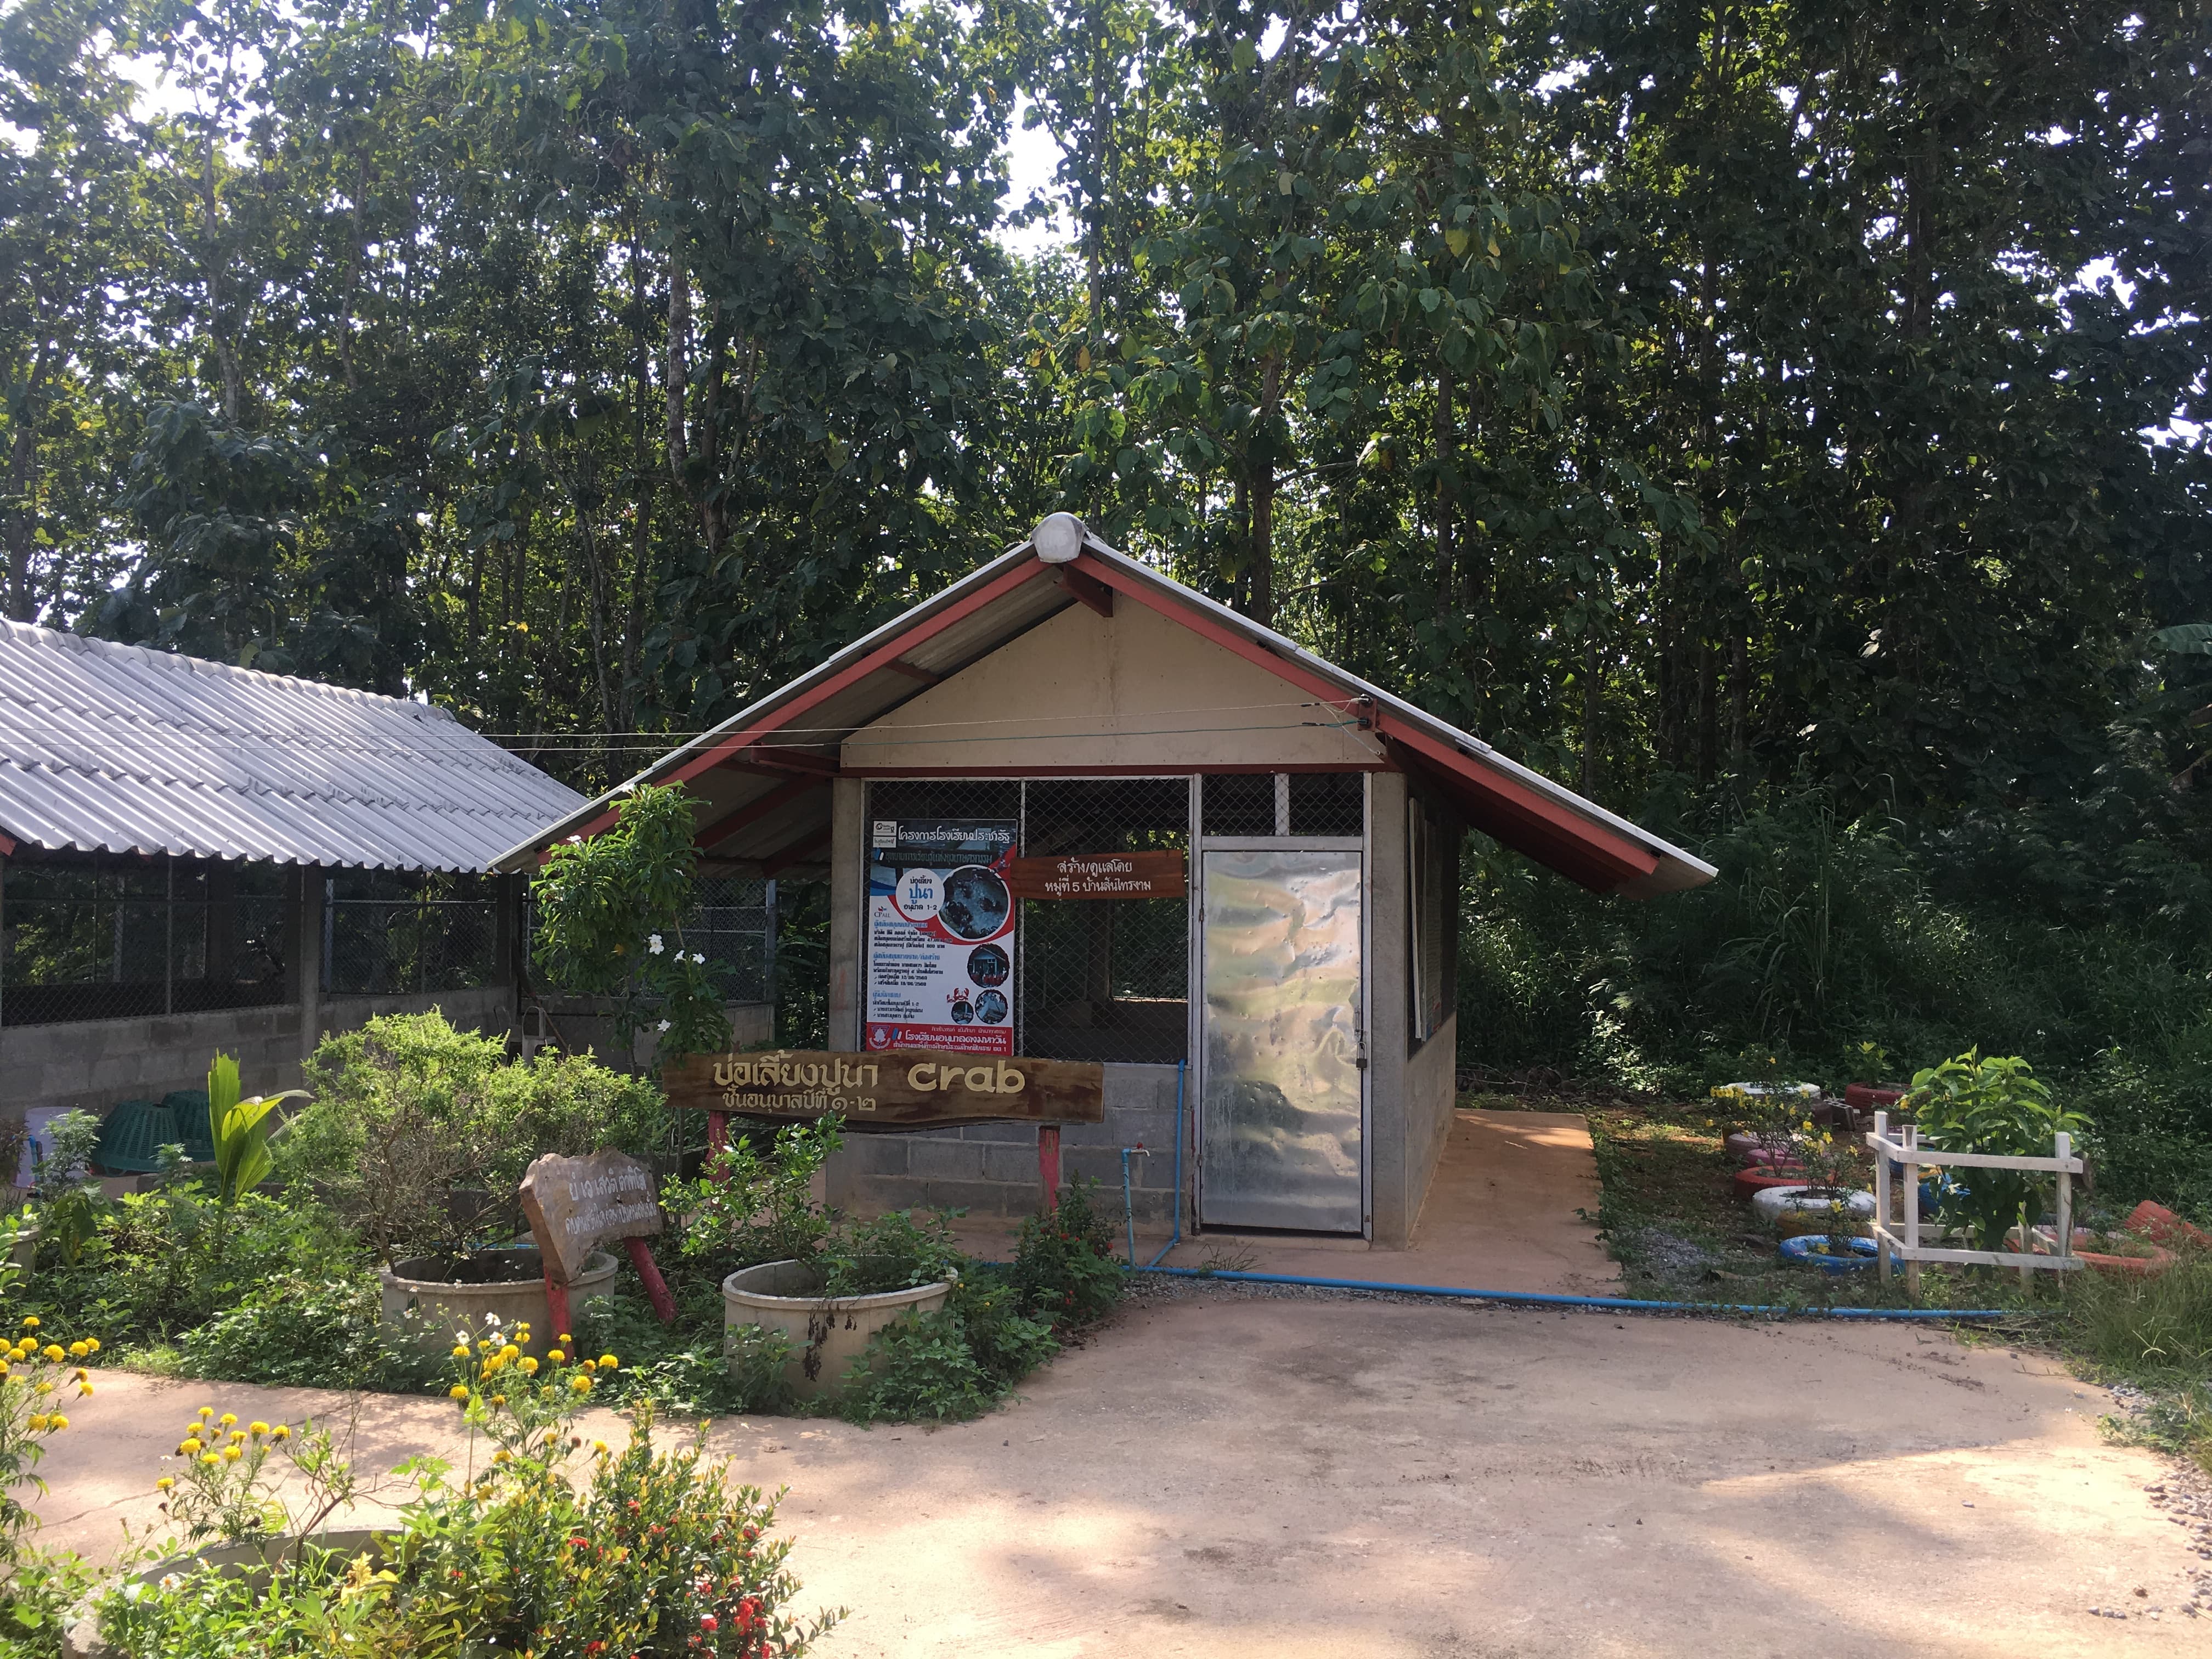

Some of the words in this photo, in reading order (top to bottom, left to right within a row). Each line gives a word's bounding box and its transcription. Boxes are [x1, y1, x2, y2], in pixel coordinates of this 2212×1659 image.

[898, 826, 1010, 844] โครงการโรงเรียนประชารัฐ
[1057, 856, 1132, 877] สร้าง/ดูแลโดย
[910, 875, 933, 884] บ่อเลี้ยง
[1045, 874, 1070, 896] หมู่ที่
[1073, 882, 1080, 892] 5
[909, 884, 933, 904] ปูนา
[713, 1049, 878, 1096] บ่อเลี้ยงปูนา
[907, 1059, 1025, 1094] crab
[722, 1083, 828, 1113] ชั้นอนุบาลปีที่
[831, 1096, 876, 1112] ๑-๒
